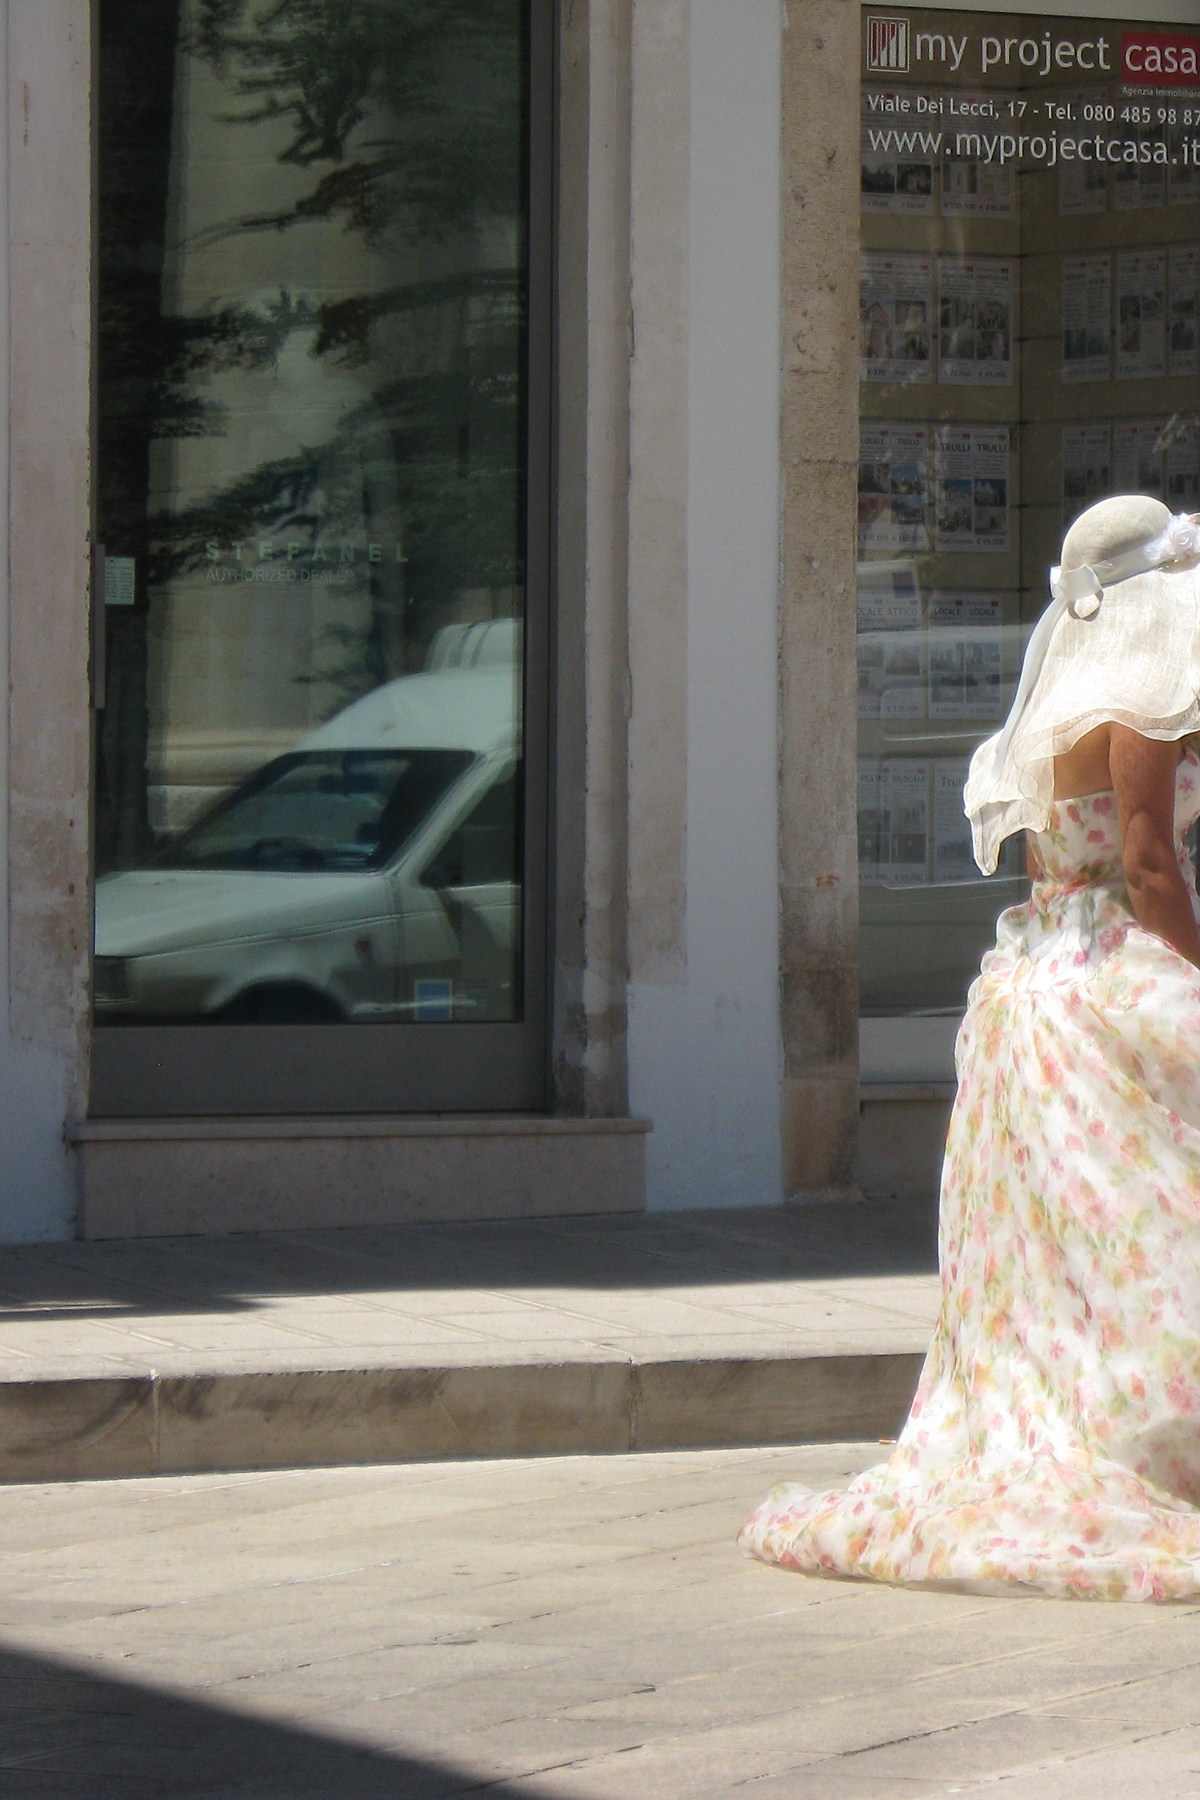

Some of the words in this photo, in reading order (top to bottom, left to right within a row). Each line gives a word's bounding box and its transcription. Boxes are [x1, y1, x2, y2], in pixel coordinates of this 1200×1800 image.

[916, 33, 968, 71] my
[981, 32, 1111, 76] project
[1125, 44, 1198, 75] casa
[868, 94, 910, 113] Viale
[917, 96, 943, 114] Dei
[950, 98, 999, 120] Lecci,
[1008, 101, 1026, 118] 17
[1044, 103, 1076, 121] Tel.
[1083, 105, 1114, 122] 080
[1120, 107, 1150, 123] 485
[1157, 108, 1177, 125] 98
[205, 541, 408, 563] STEFANEL
[206, 568, 297, 582] AUTHORIZED
